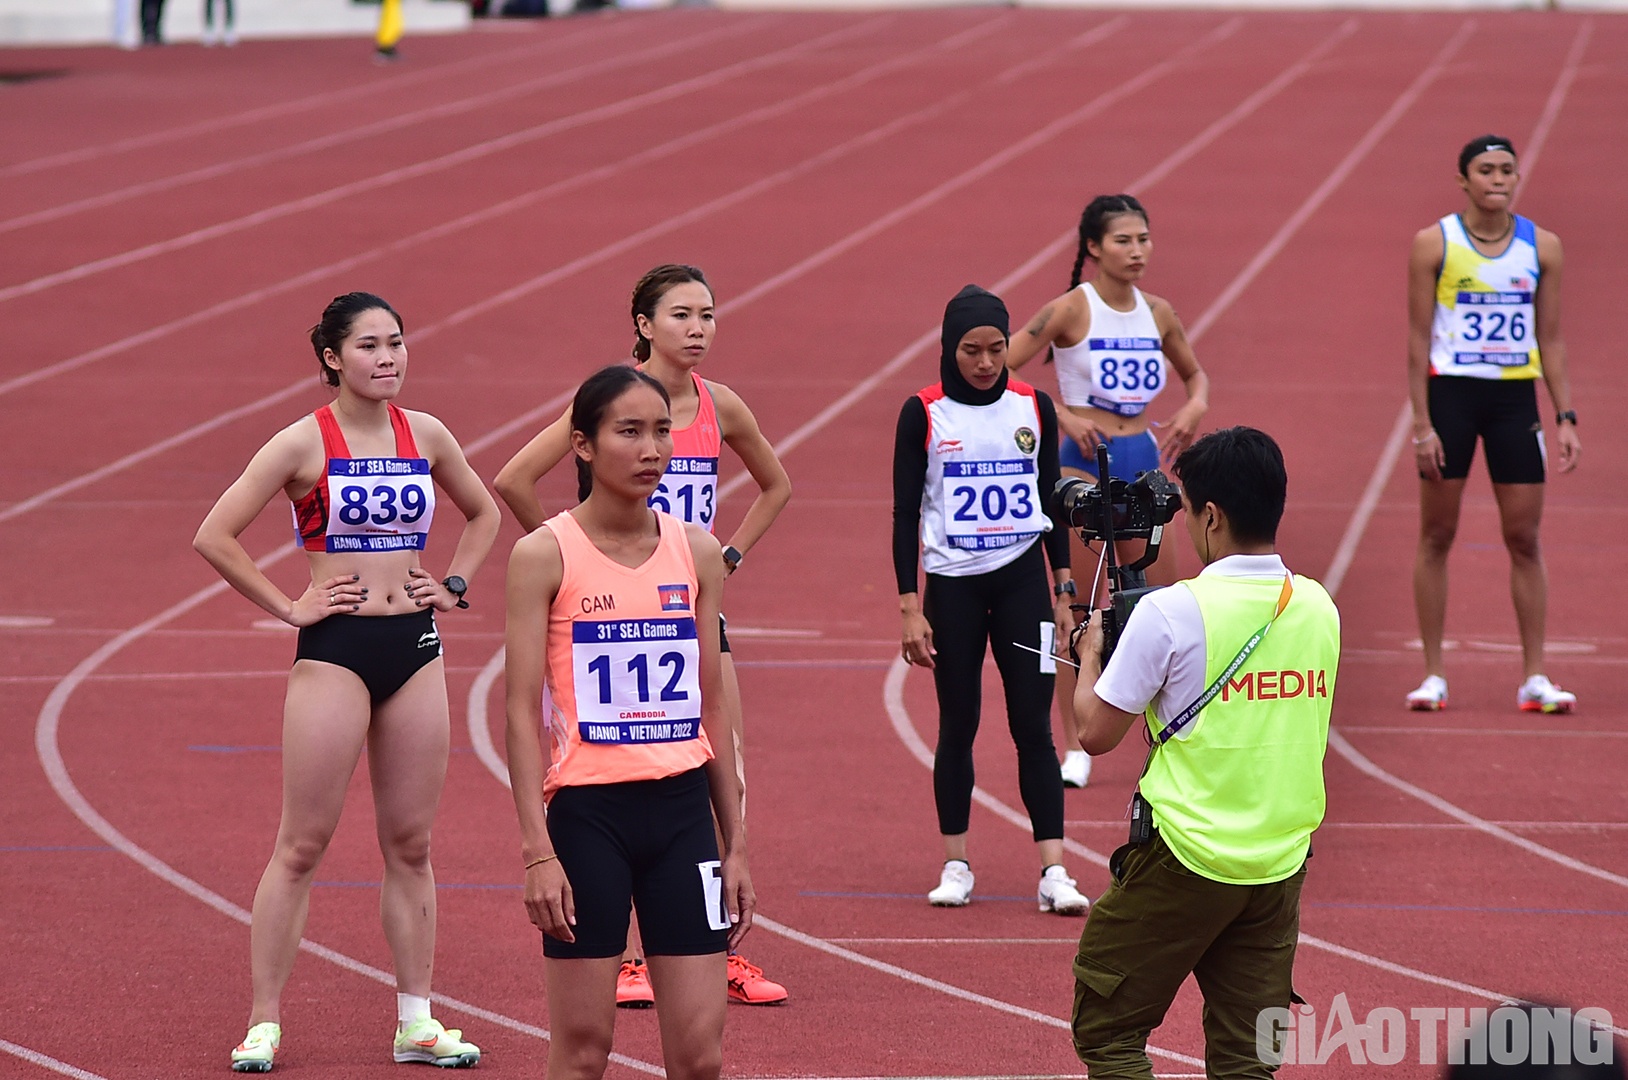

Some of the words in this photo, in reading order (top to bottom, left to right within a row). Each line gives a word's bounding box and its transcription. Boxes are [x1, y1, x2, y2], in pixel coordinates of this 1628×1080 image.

[1463, 311, 1526, 342] 326
[1100, 357, 1160, 391] 838
[366, 460, 385, 474] SEA
[385, 460, 412, 474] Games
[670, 459, 688, 472] SEA
[690, 460, 712, 472] Games
[977, 463, 994, 475] SEA
[995, 462, 1024, 474] Games
[338, 484, 427, 526] 839
[646, 482, 713, 524] 613
[953, 483, 1034, 522] 203
[333, 536, 363, 550] HANOI
[368, 534, 404, 549] VIETNAM
[581, 594, 616, 614] CAM
[619, 623, 640, 639] SEA
[643, 622, 678, 638] Games
[1249, 634, 1261, 649] FOR
[587, 651, 689, 704] 112
[1218, 652, 1247, 686] STRONGER
[1221, 670, 1328, 703] MEDIA
[1188, 683, 1220, 714] SOUTHEAST
[619, 710, 667, 719] CAMBODIA
[1176, 713, 1190, 725] ASIA
[588, 726, 621, 740] HANOI
[630, 724, 671, 740] VIETNAM
[672, 722, 693, 738] 2022
